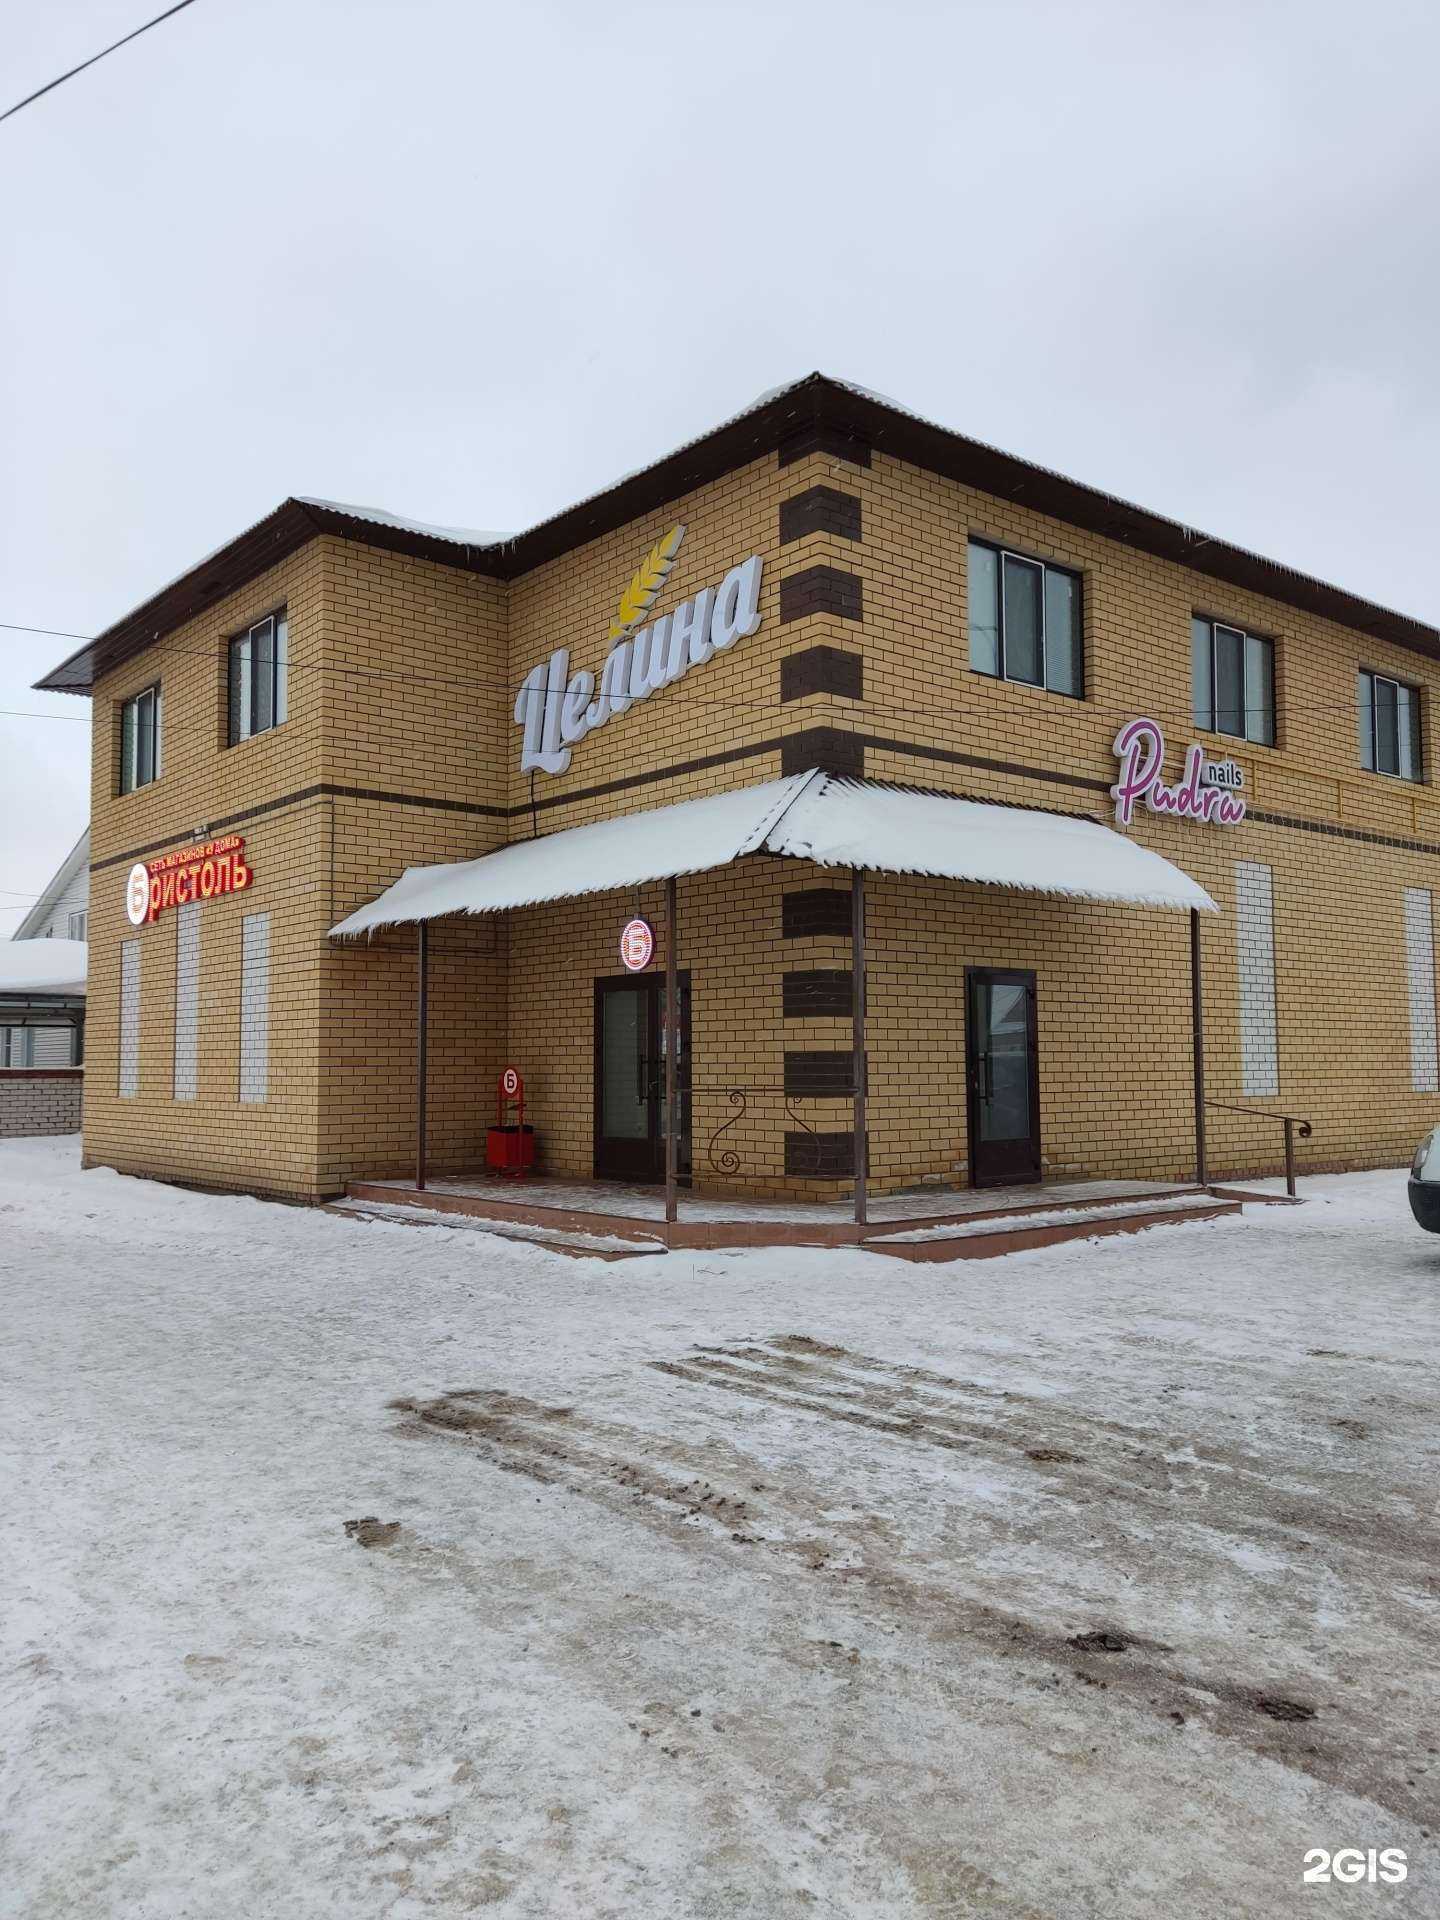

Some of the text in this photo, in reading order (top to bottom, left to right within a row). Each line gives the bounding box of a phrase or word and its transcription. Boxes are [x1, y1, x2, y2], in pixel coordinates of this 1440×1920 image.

[514, 555, 764, 775] Целина
[1110, 717, 1245, 826] Pudra
[1208, 764, 1243, 787] nails
[506, 1073, 515, 1089] Б
